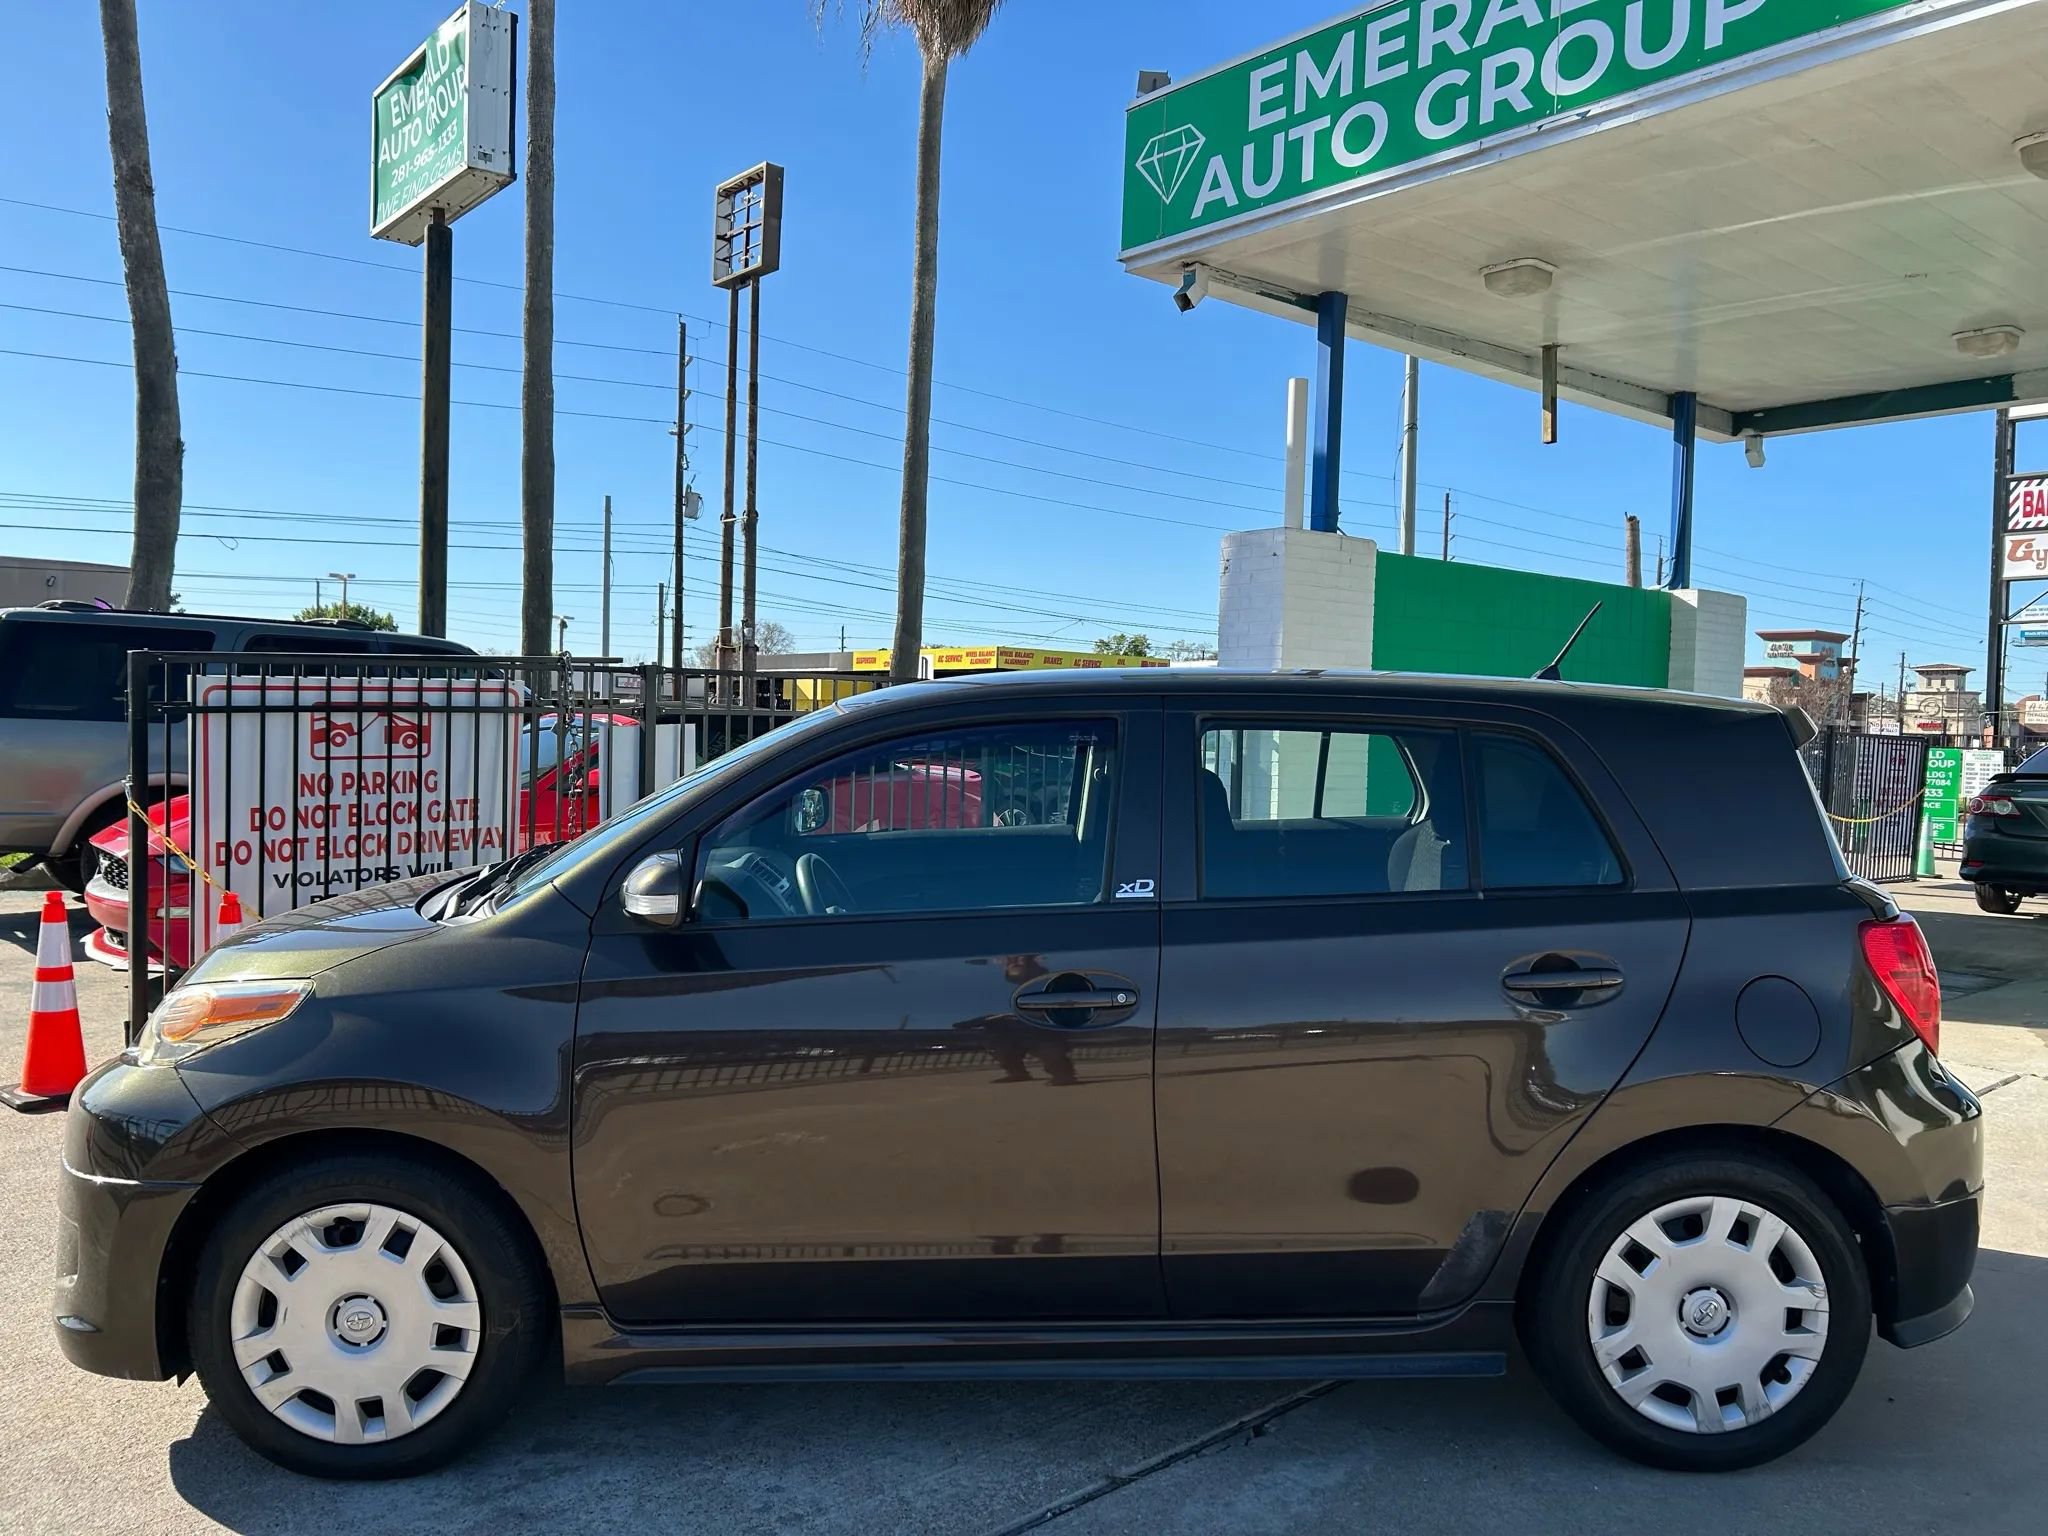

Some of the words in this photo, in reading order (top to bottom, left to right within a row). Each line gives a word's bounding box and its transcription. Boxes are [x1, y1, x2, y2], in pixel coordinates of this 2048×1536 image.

[1249, 0, 1600, 132] EMERA
[1191, 101, 1388, 220] AUTO
[1414, 0, 1768, 141] GROUP
[378, 117, 422, 168] AUTO
[400, 171, 428, 208] FIND
[2023, 489, 2048, 518] BA
[945, 654, 963, 662] SERVICE
[300, 772, 334, 797] NO
[341, 769, 438, 796] PARKING
[250, 806, 286, 832] DO
[295, 804, 341, 829] NOT
[348, 800, 418, 827] BLOCK
[427, 798, 480, 823] GATE
[216, 840, 252, 867] DO
[263, 837, 309, 863] NOT
[316, 832, 387, 860] BLOCK
[397, 826, 505, 855] DRIVEWAY
[273, 865, 401, 889] VIOLATORS
[1117, 879, 1154, 893] xD
